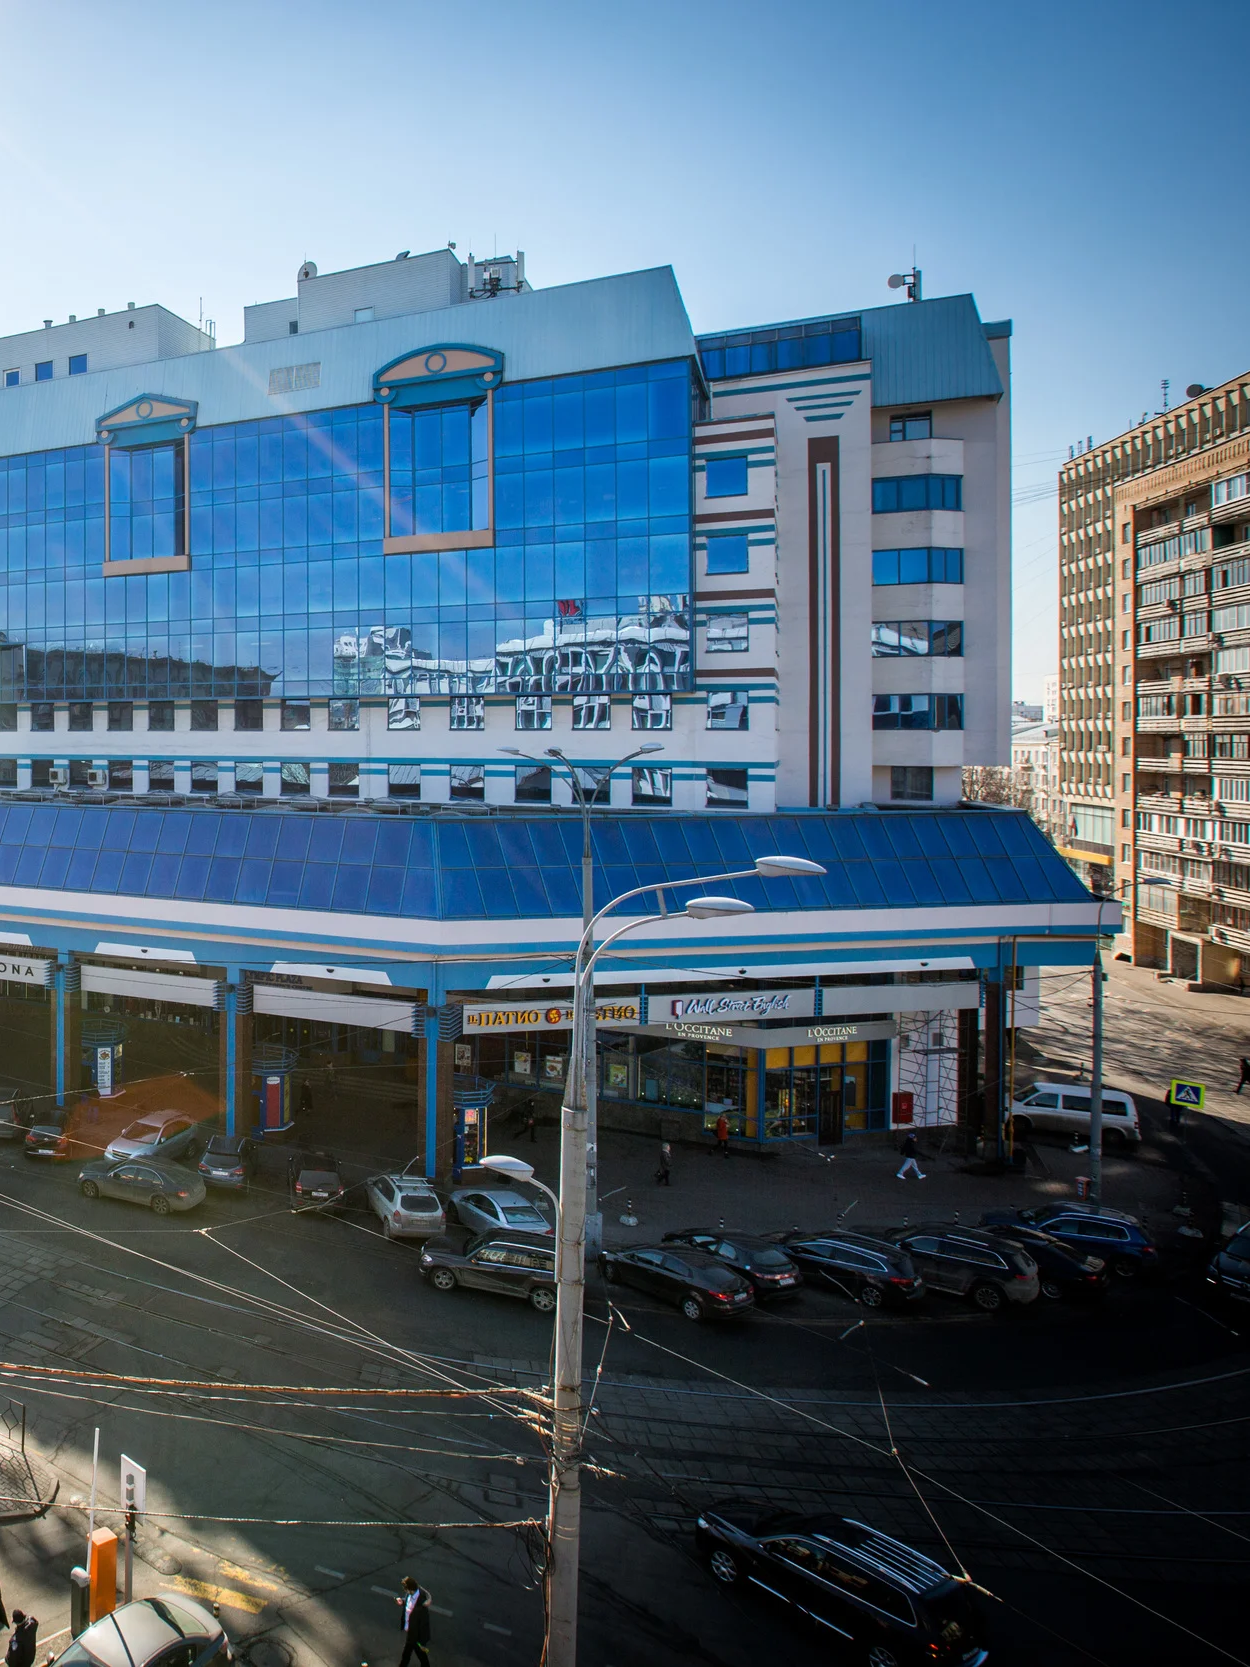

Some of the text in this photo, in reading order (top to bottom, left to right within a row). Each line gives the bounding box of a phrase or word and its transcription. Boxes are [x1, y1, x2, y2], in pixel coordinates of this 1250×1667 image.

[595, 1005, 637, 1021] АТИО
[686, 995, 791, 1016] Wall Street English
[479, 1009, 541, 1027] ПАТИО
[688, 1033, 720, 1041] PROVENCE
